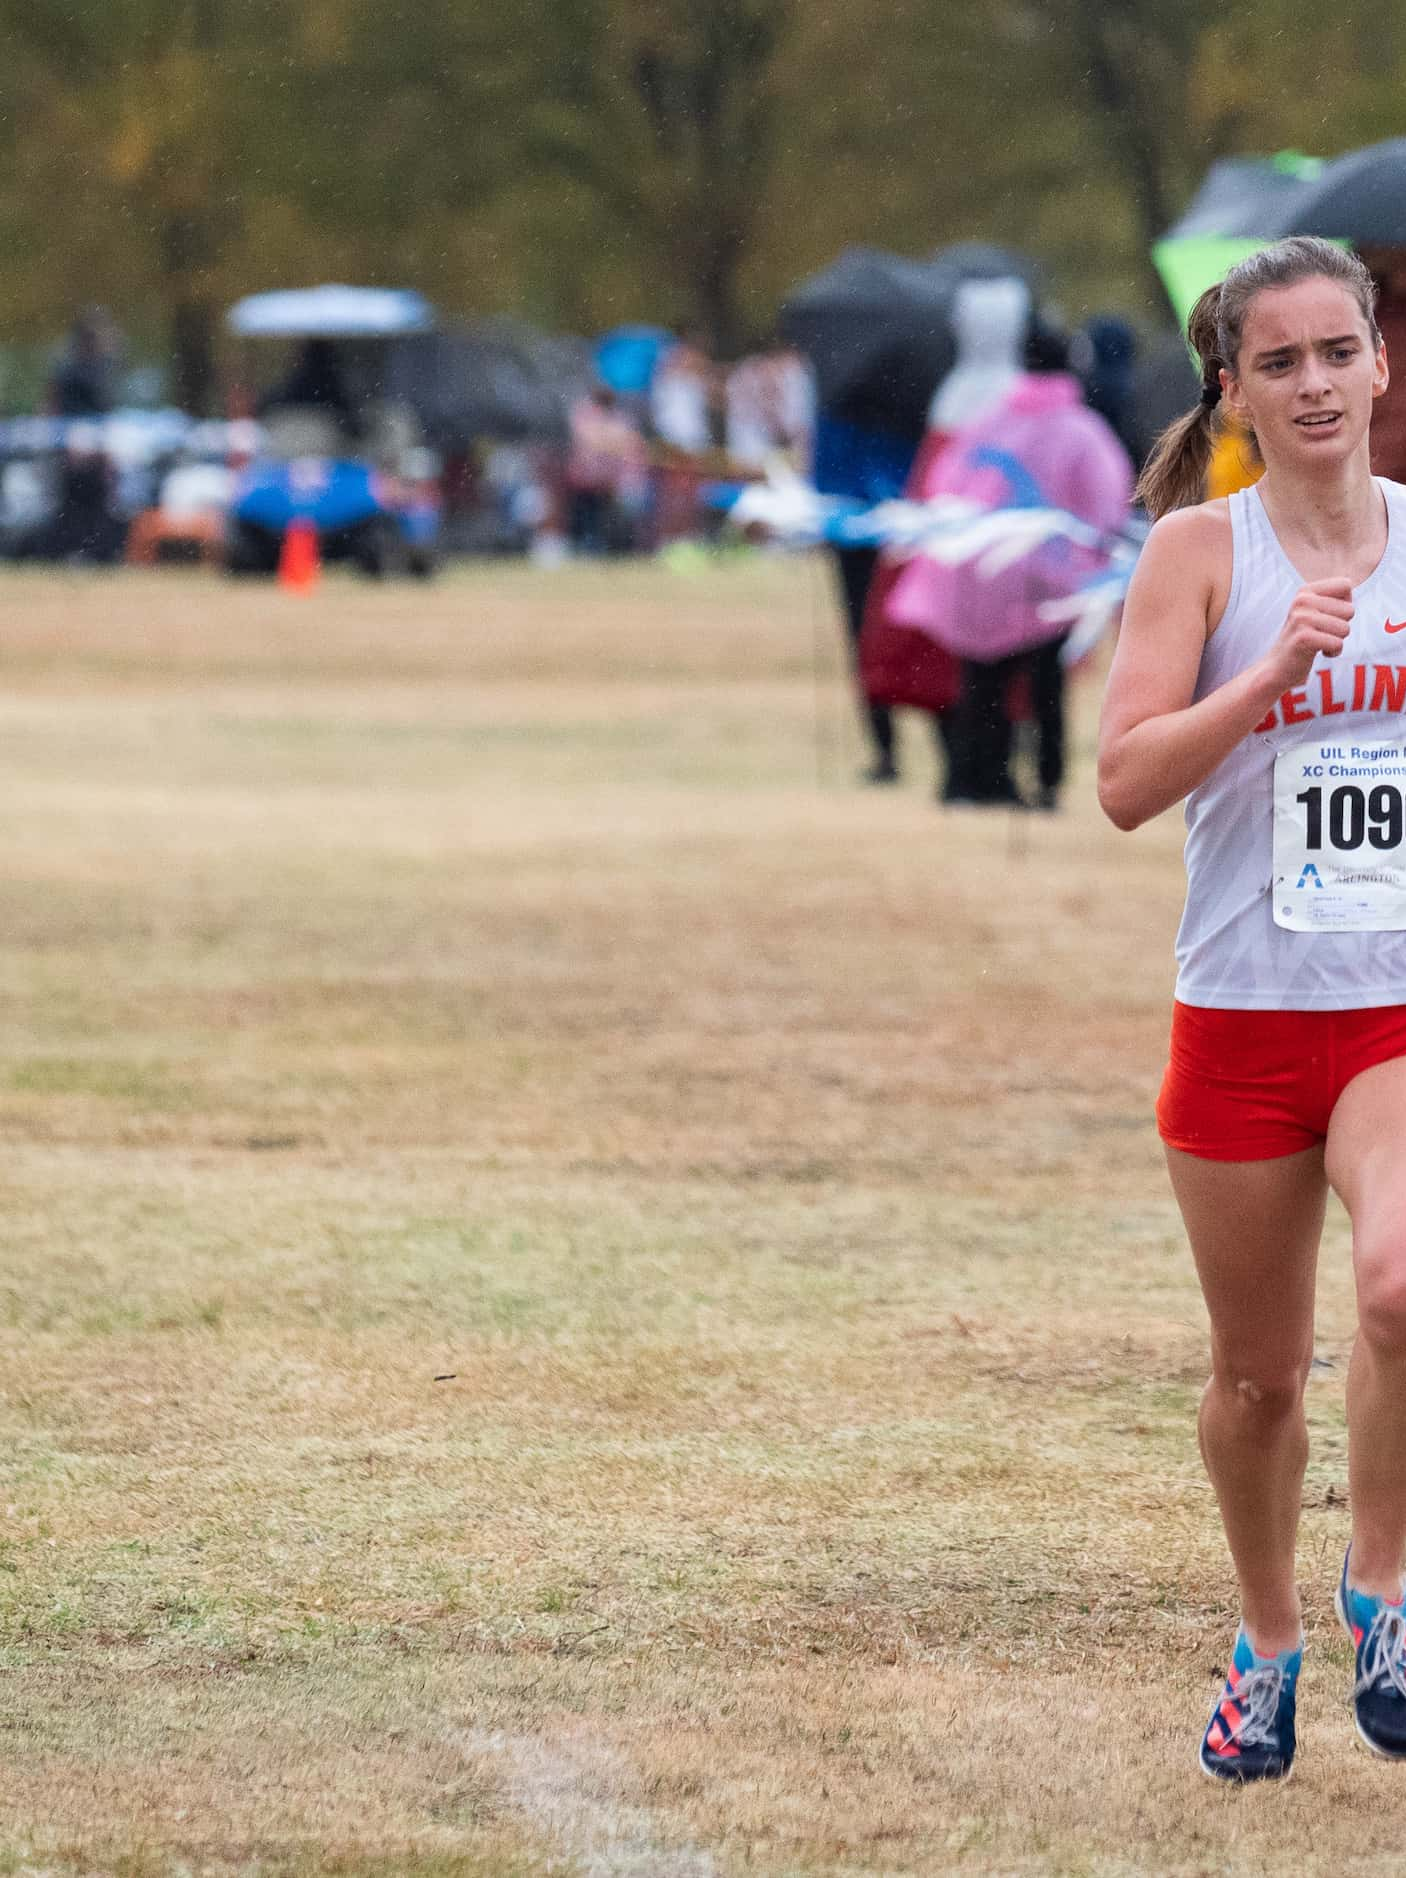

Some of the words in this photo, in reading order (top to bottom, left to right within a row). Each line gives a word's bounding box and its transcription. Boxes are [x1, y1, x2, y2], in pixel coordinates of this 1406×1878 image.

[1320, 747, 1346, 760] UIL
[1351, 747, 1398, 761] Region
[1303, 765, 1323, 777] XC
